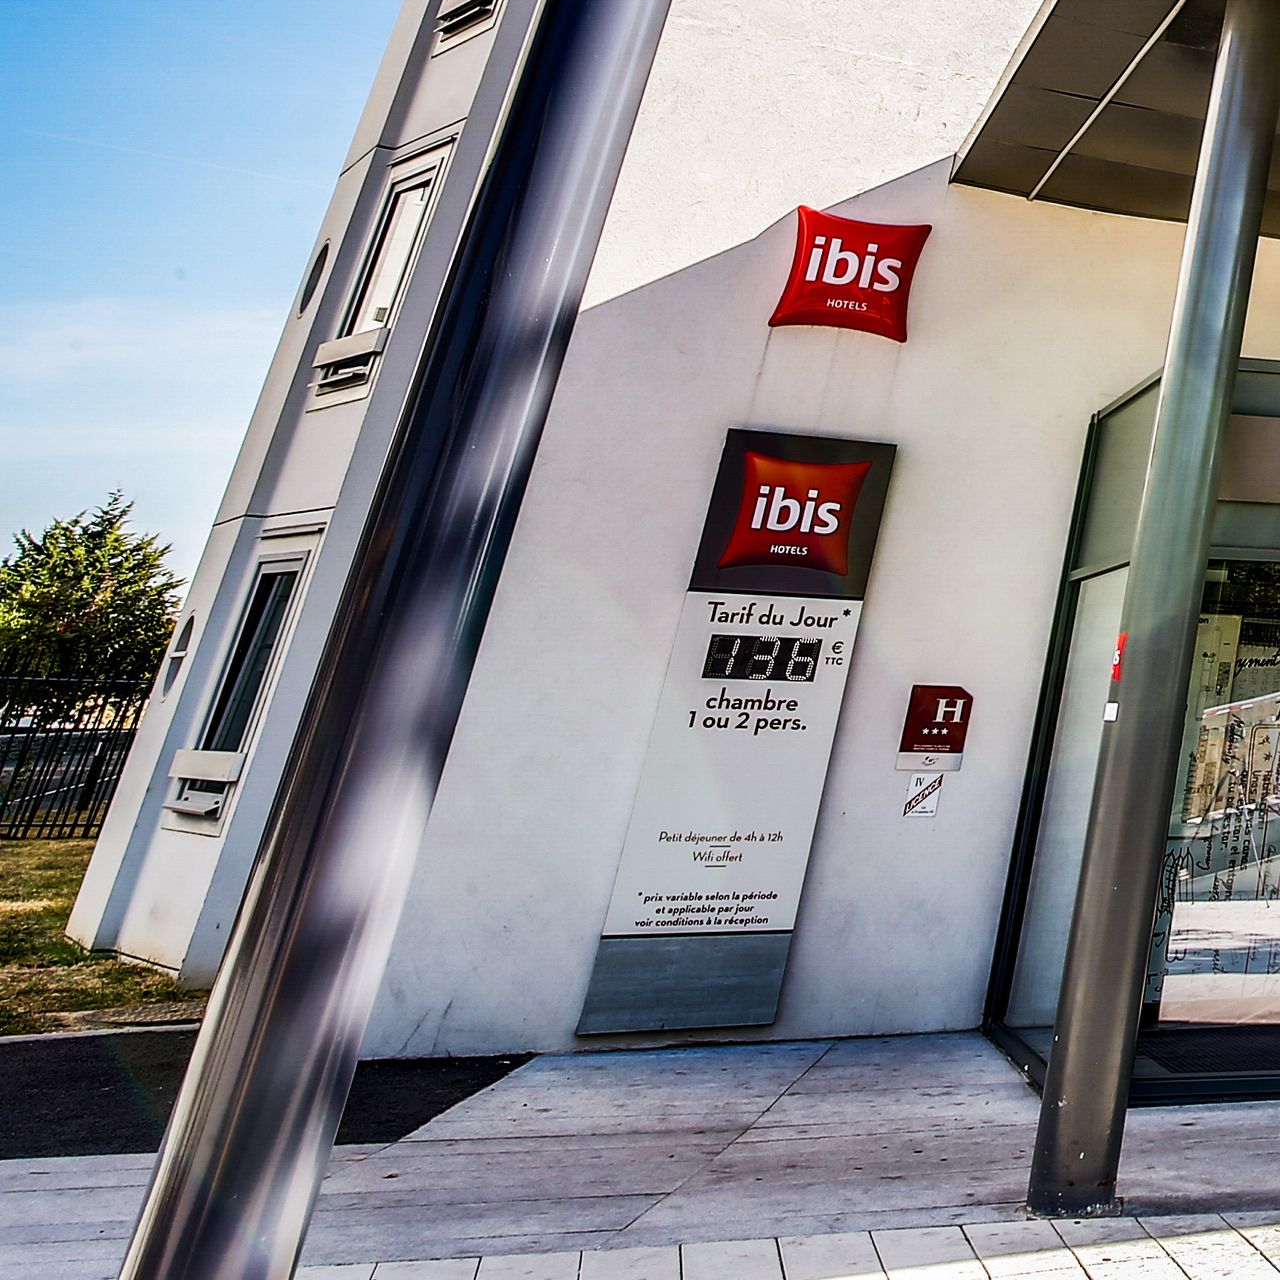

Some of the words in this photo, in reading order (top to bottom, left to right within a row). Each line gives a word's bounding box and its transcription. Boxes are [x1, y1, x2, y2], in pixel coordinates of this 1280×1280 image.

[804, 235, 902, 292] ibis
[826, 298, 868, 311] HOTELS
[751, 485, 841, 535] ibis
[770, 544, 808, 556] HOTELS
[707, 601, 757, 624] Tarif
[758, 603, 785, 626] du
[832, 641, 844, 654] €
[825, 657, 844, 666] TTC
[706, 687, 799, 712] chambre
[932, 698, 967, 723] H
[688, 711, 696, 728] 1
[702, 714, 730, 729] ou
[735, 711, 752, 730] 2
[754, 716, 808, 736] pers.
[659, 831, 682, 842] Petit
[684, 831, 728, 845] déjeuner
[729, 831, 742, 842] de
[744, 831, 757, 842] 4h
[758, 832, 765, 842] à
[767, 831, 784, 842] 12h
[692, 851, 714, 862] Wifi
[716, 850, 743, 862] offert
[666, 892, 703, 902] variable
[705, 892, 730, 901] selon
[731, 891, 740, 900] la
[741, 891, 778, 904] période
[655, 905, 666, 915] et
[667, 904, 716, 916] applicable
[717, 905, 733, 915] par
[734, 904, 754, 915] jour
[634, 918, 653, 928] voir
[655, 917, 704, 927] conditions
[705, 916, 712, 926] à
[713, 916, 722, 925] la
[723, 915, 769, 927] réception
